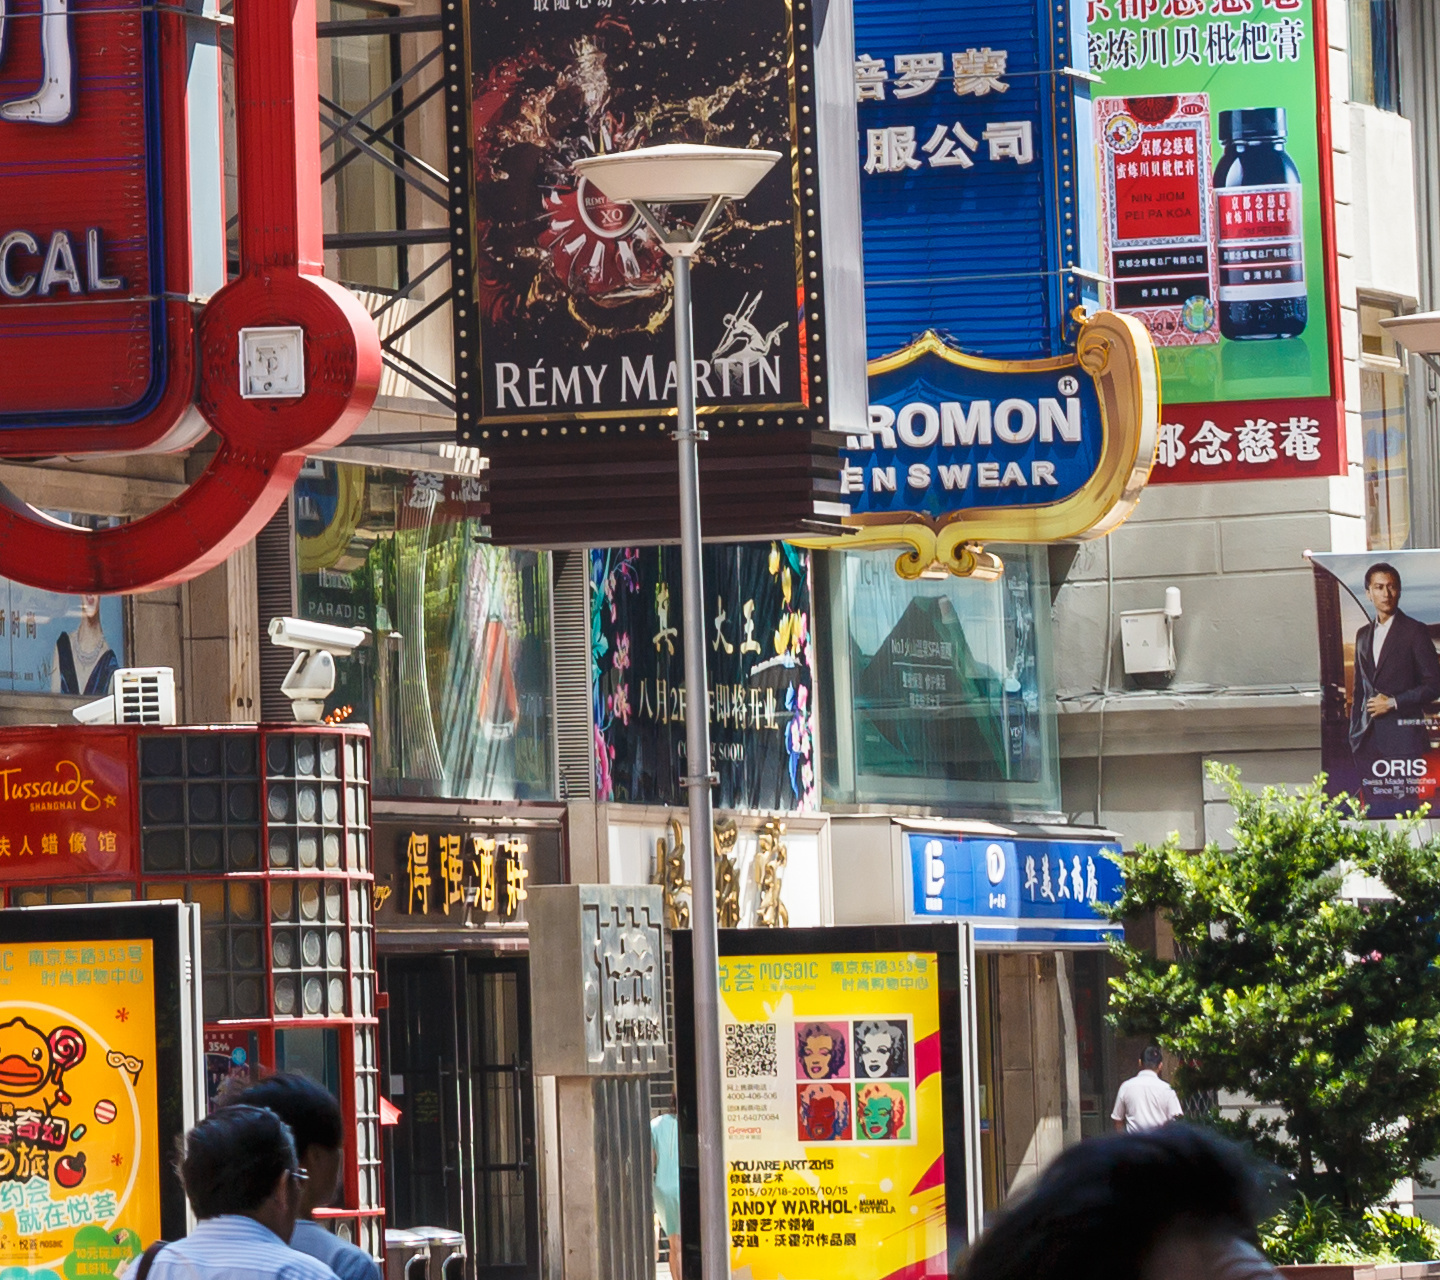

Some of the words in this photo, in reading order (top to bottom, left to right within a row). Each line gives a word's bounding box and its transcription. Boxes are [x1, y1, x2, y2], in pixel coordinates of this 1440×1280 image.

[1131, 192, 1153, 202] NIN
[1156, 191, 1185, 201] JIOM
[601, 209, 624, 223] XO
[1125, 210, 1146, 220] PEI
[1148, 209, 1164, 219] PA
[1166, 208, 1192, 218] KOA
[309, 602, 366, 620] PARADIS
[1372, 759, 1427, 777] ORIS
[30, 801, 76, 811] SHANGHAI
[831, 959, 928, 975] 南京东路353号
[730, 1160, 755, 1172] YOU
[756, 1160, 780, 1172] ARE
[783, 1159, 808, 1171] ART
[808, 1159, 834, 1171] 2015
[731, 1186, 848, 1197] 2015/07/18-2015/10/15
[17, 1191, 117, 1234] 就在悦荟
[731, 1200, 777, 1216] ANDY
[782, 1199, 852, 1215] WARHOL
